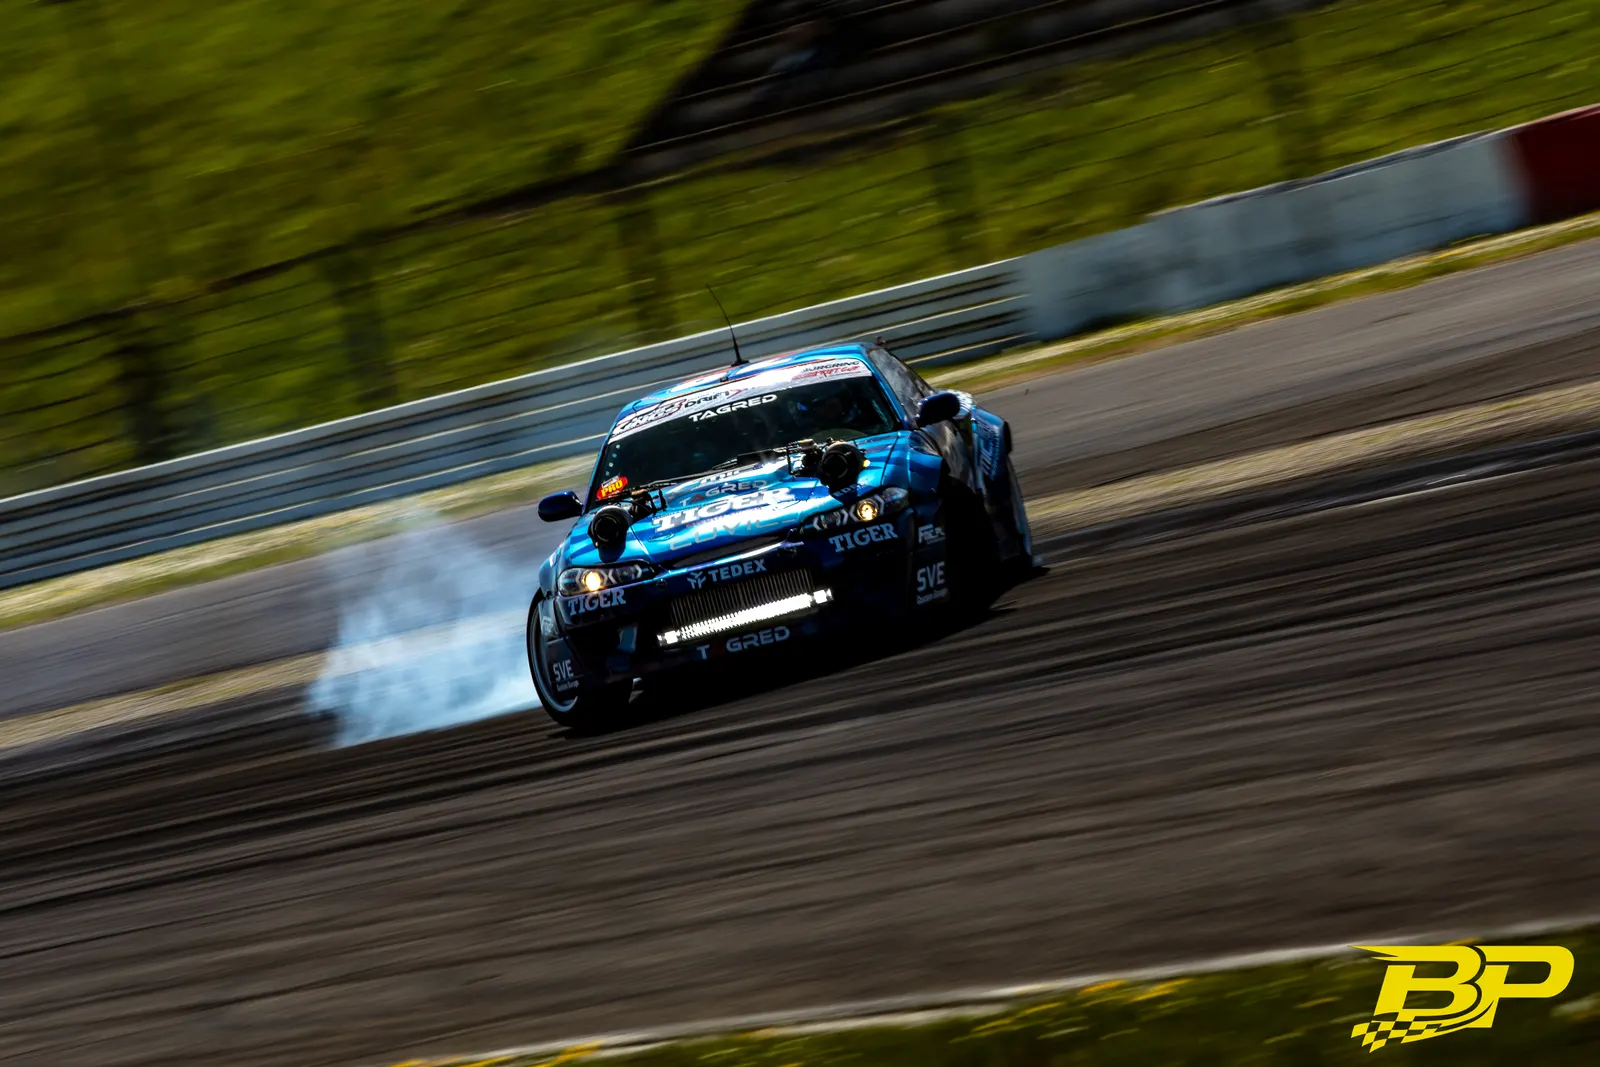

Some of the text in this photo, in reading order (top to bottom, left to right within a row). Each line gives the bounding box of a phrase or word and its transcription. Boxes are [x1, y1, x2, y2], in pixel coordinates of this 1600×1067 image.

[688, 393, 778, 423] TAGRED
[600, 479, 624, 498] PRO
[679, 479, 768, 508] TAGRED
[653, 487, 796, 533] TIGER
[828, 522, 899, 553] TIGER
[708, 558, 768, 582] TEDEX
[916, 561, 946, 593] SVE
[568, 588, 627, 617] TIGER
[696, 625, 791, 660] TGRED
[552, 659, 574, 681] SVE
